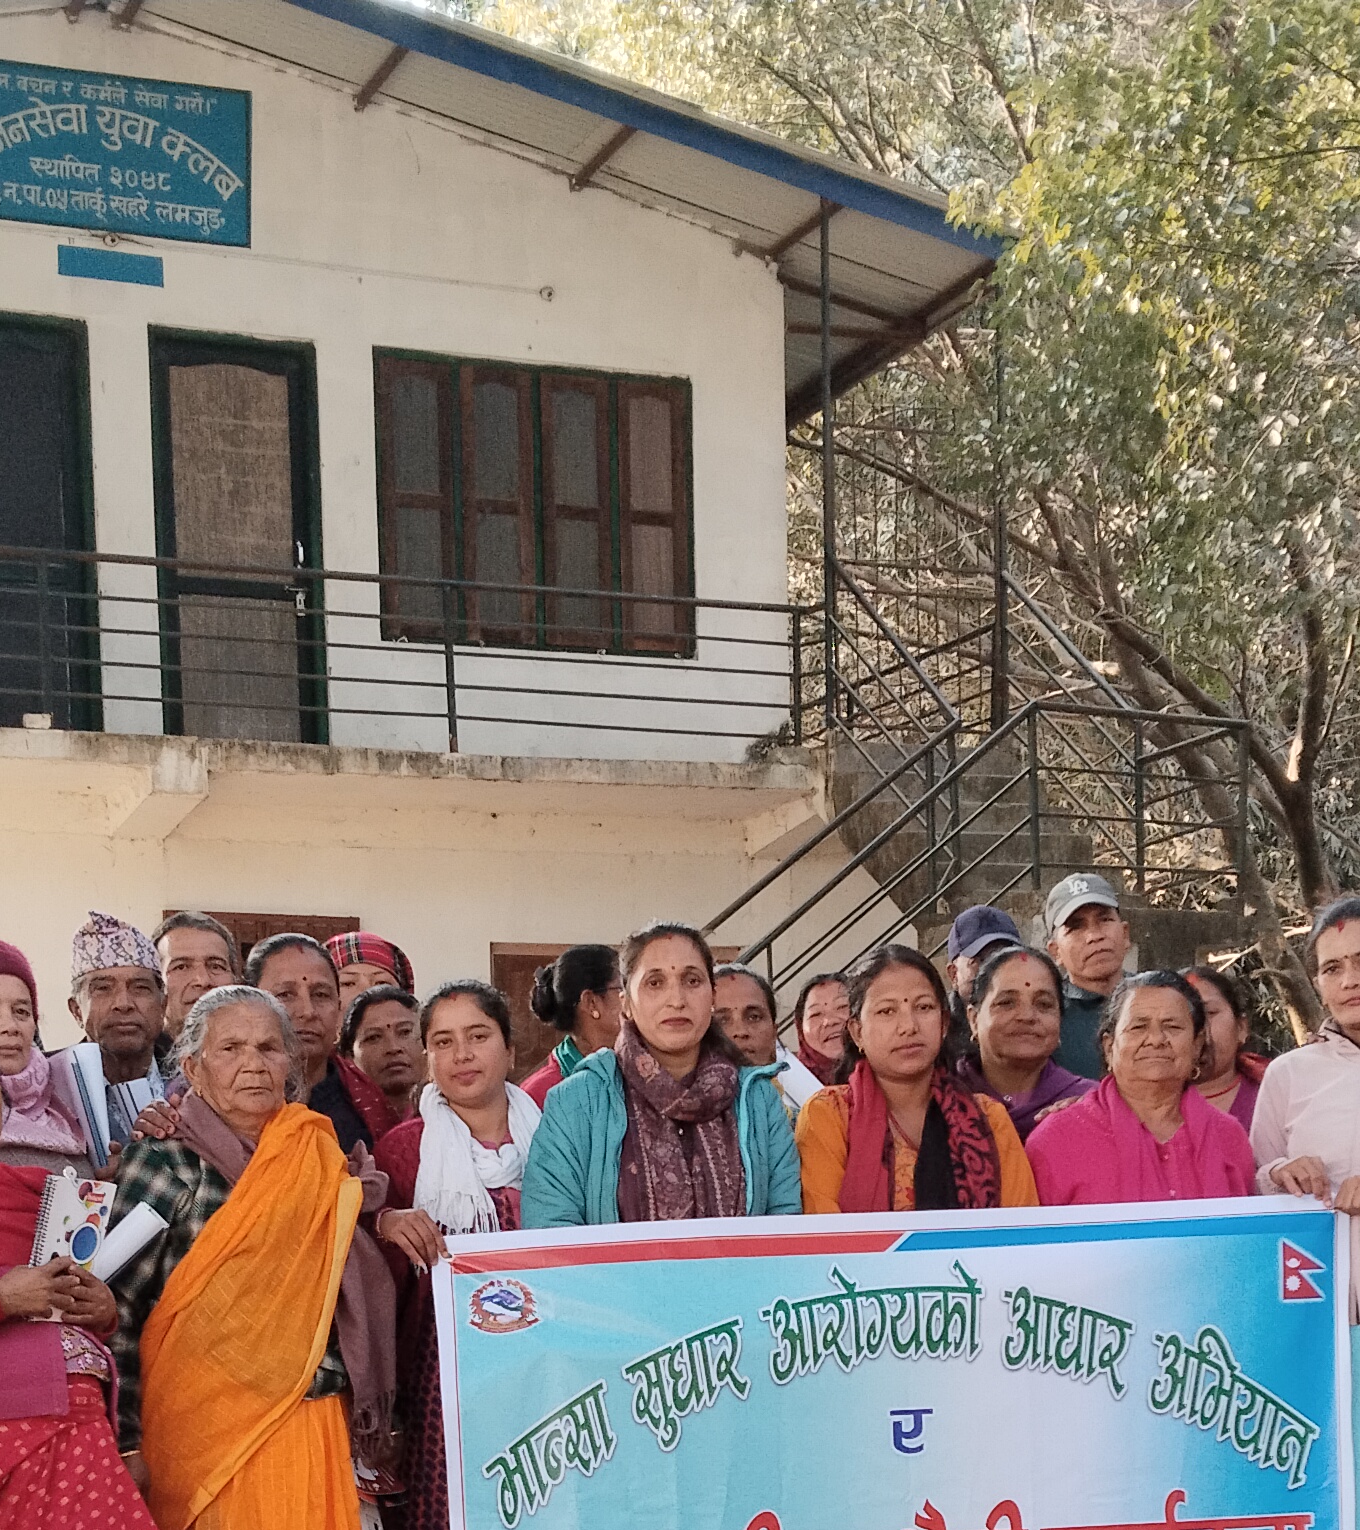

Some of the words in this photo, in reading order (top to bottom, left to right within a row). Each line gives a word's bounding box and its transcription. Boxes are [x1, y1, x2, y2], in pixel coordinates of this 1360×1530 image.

[62, 81, 74, 97] र
[134, 84, 169, 109] सेवा
[29, 154, 101, 184] स्थापित
[109, 166, 171, 191] २०४८
[96, 105, 160, 151] युवा
[161, 127, 244, 201] क्लब
[485, 1382, 614, 1526] भान्सा
[624, 1317, 748, 1449] सुधार
[762, 1259, 983, 1381] आरोग्यको
[1003, 1286, 1134, 1397] आधार
[1150, 1327, 1318, 1486] अभियान
[889, 1408, 934, 1454] र
